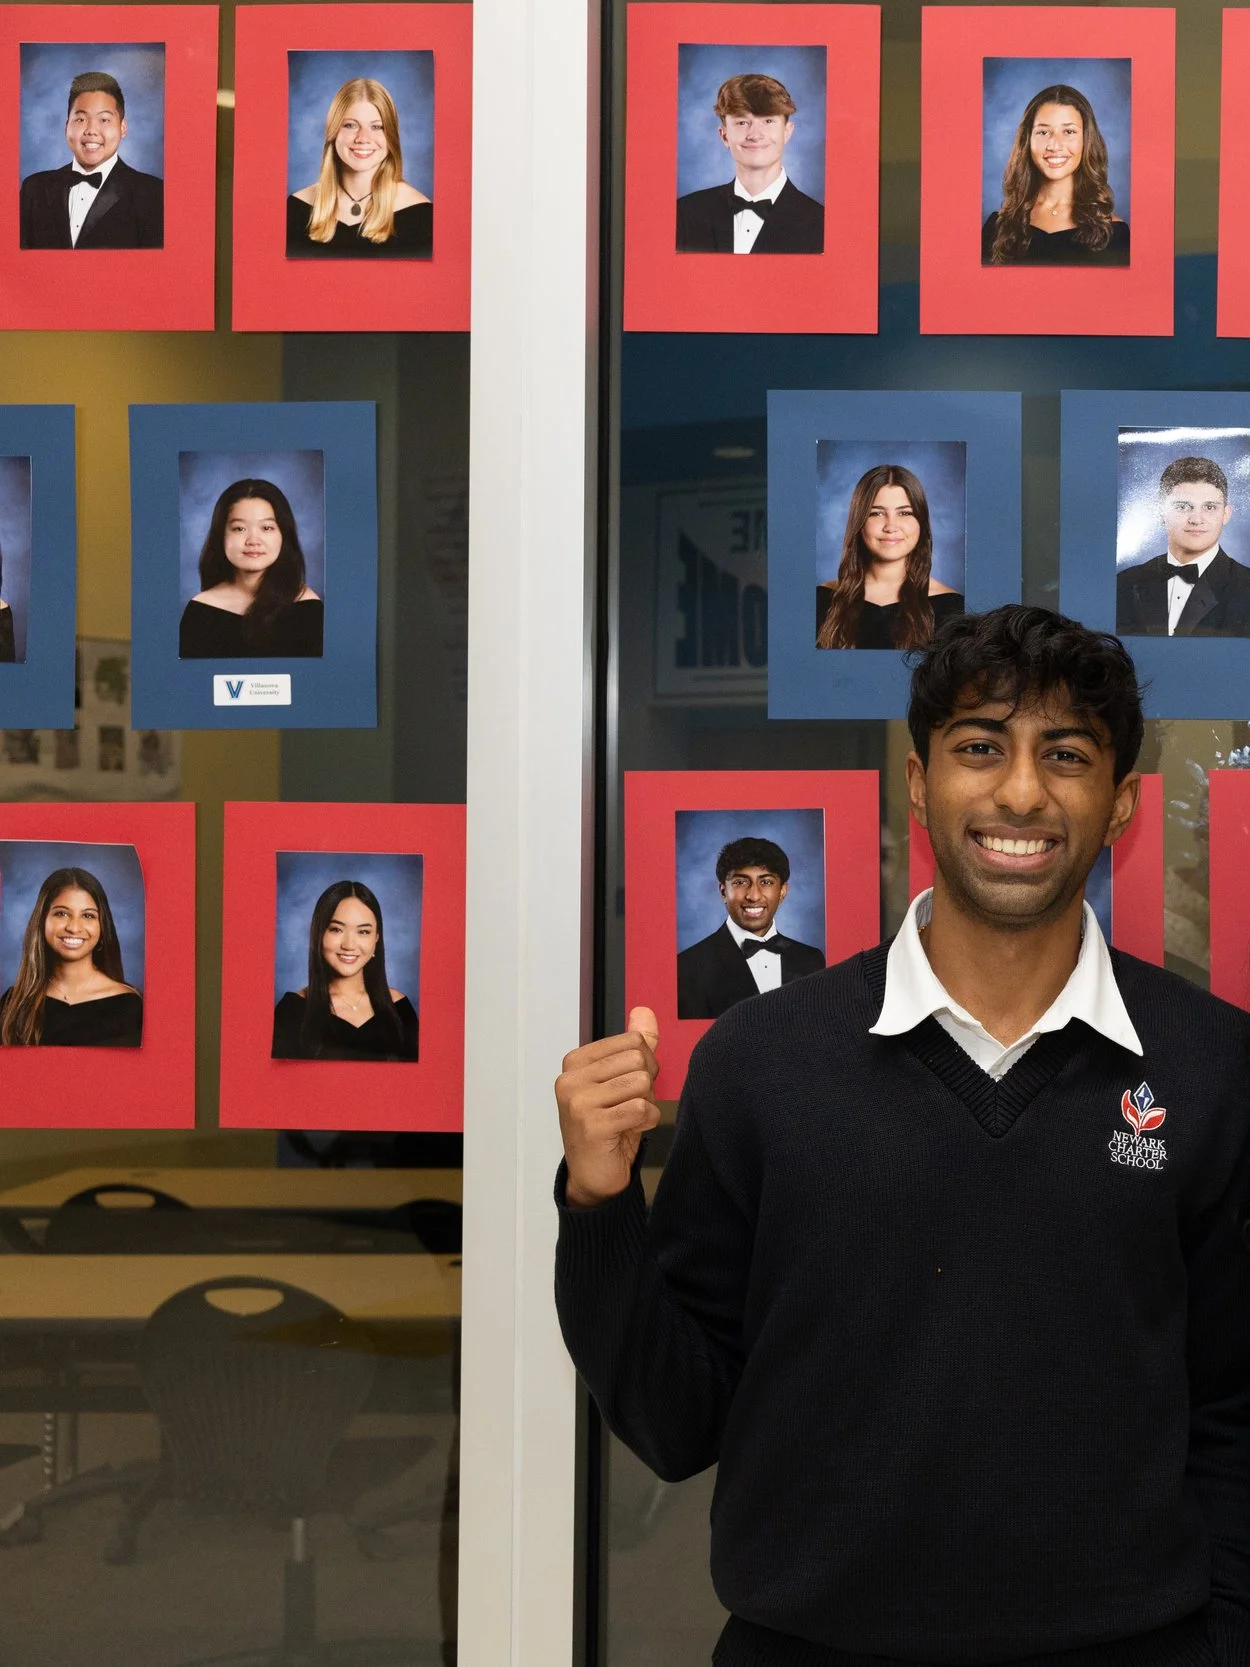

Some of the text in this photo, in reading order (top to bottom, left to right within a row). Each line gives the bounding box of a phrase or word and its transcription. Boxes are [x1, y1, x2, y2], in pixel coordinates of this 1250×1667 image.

[225, 680, 244, 699] V
[1112, 1130, 1165, 1150] NEWARK
[1108, 1140, 1168, 1160] CHARTER
[1110, 1151, 1164, 1170] SCHOOL
